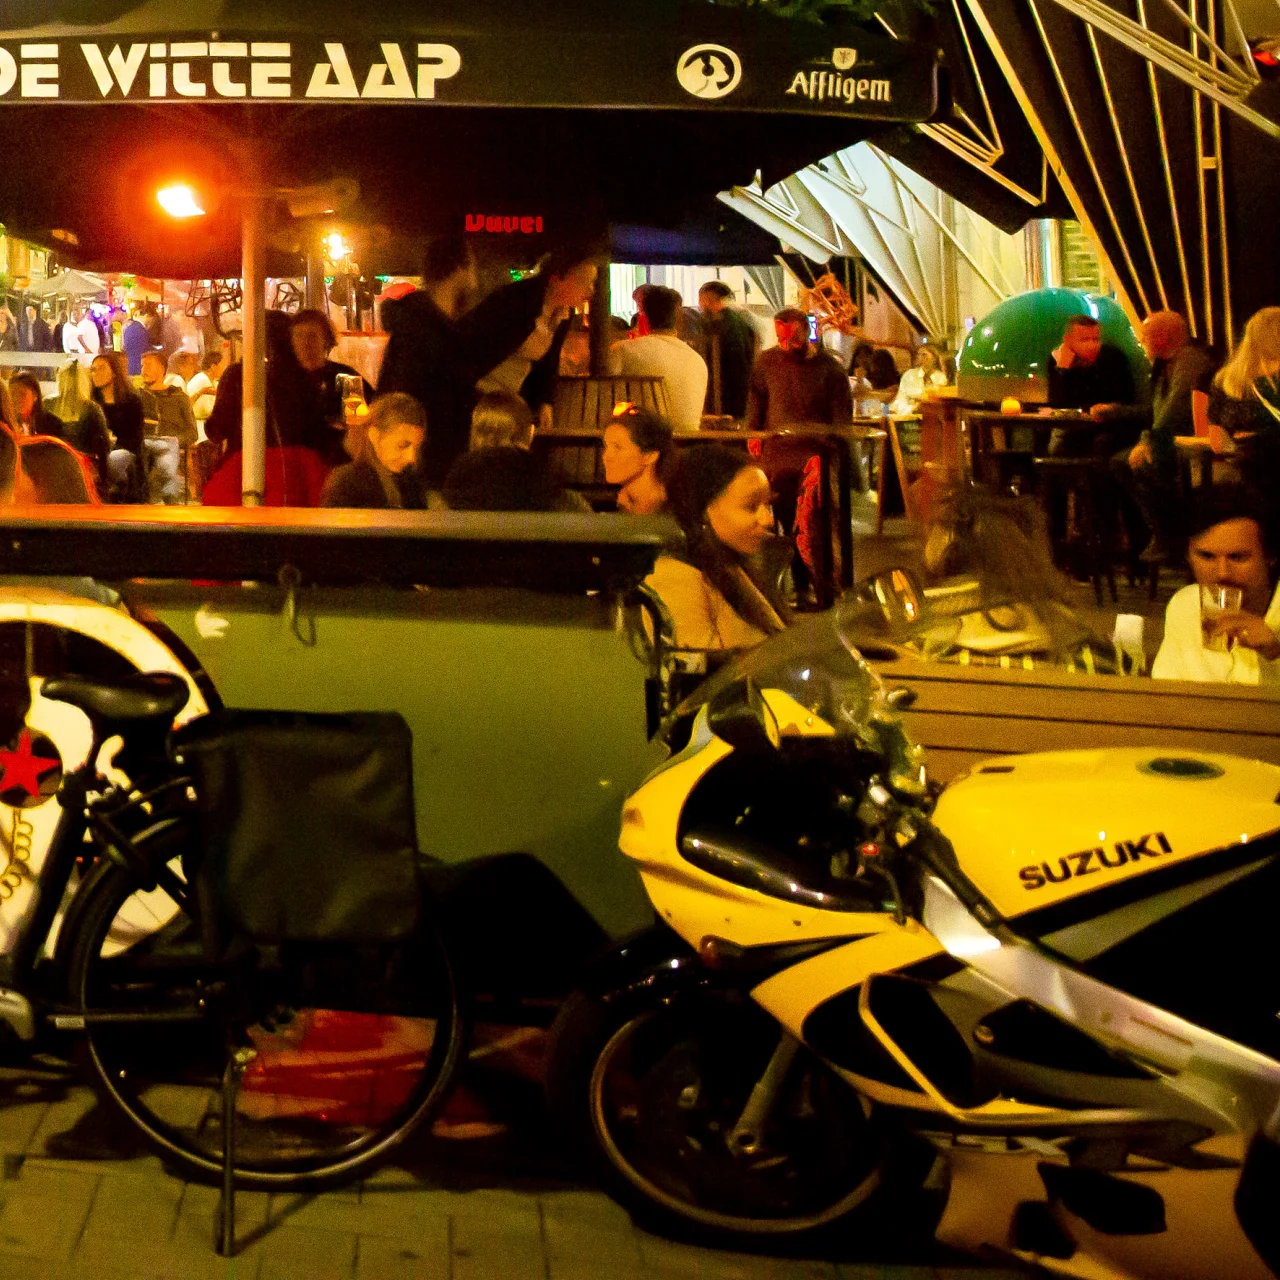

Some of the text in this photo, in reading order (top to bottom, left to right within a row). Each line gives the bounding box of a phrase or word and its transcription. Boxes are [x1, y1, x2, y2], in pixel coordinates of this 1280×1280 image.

[81, 43, 291, 98] WITTE
[306, 43, 462, 99] AAP
[785, 69, 892, 105] Affligem
[1018, 831, 1173, 891] SUZUKI
